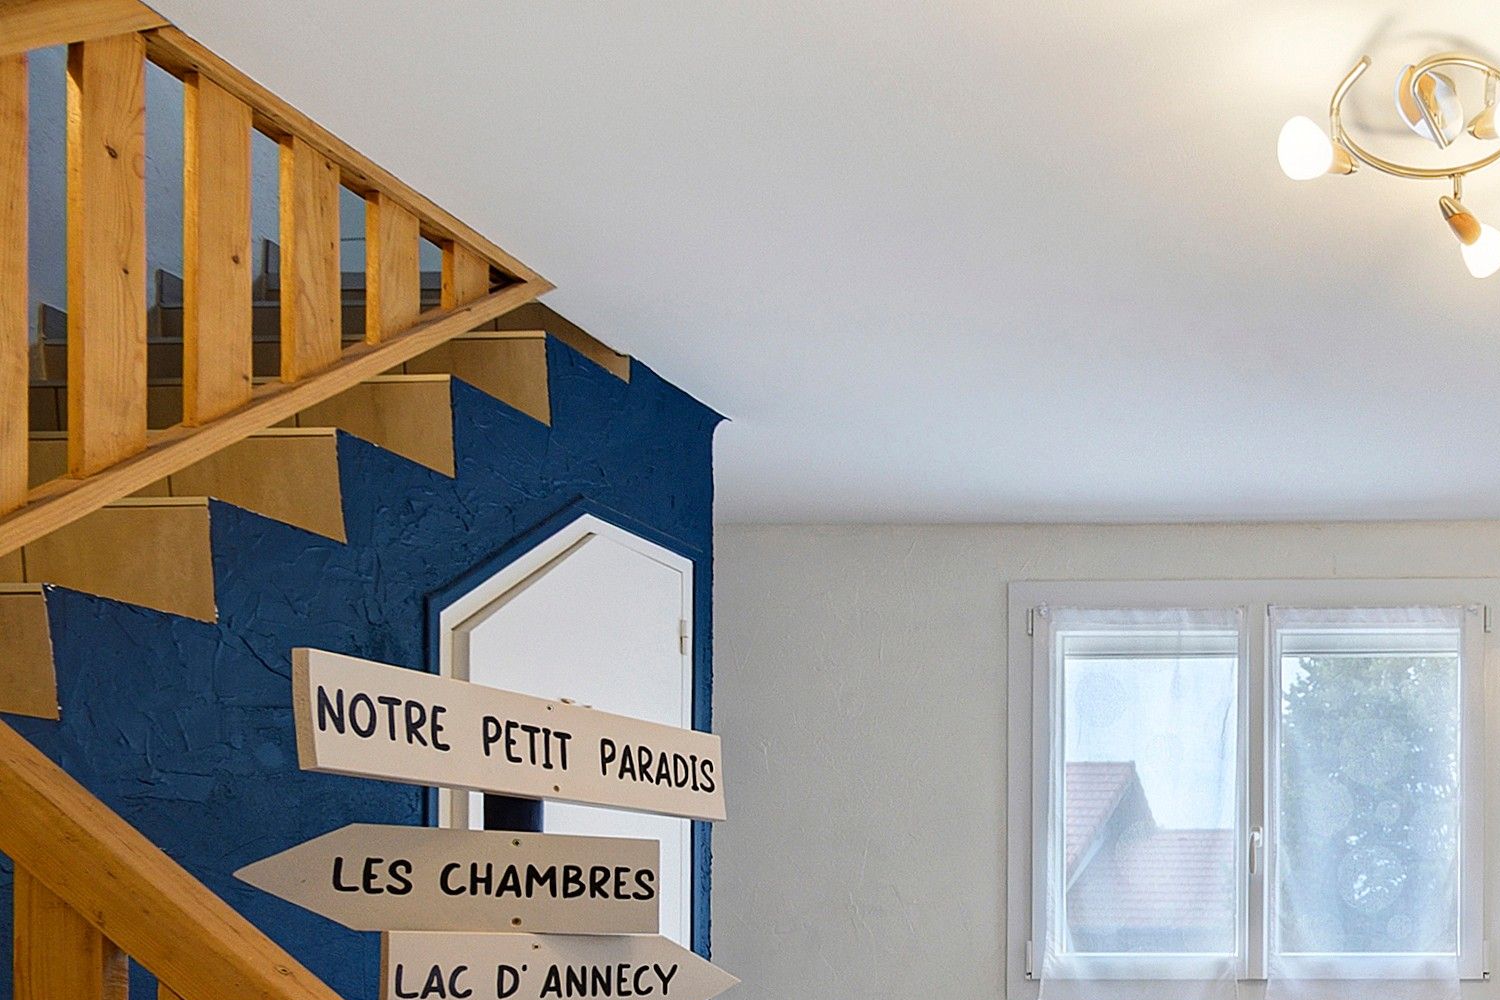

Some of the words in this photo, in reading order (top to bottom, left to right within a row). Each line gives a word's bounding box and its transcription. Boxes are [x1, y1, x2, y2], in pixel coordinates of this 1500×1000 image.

[318, 685, 450, 751] NOTRE
[483, 716, 571, 770] PETIT
[601, 739, 715, 793] PARADIS
[332, 857, 412, 895] LES
[440, 862, 655, 900] CHAMBRES
[395, 964, 472, 1000] LAC
